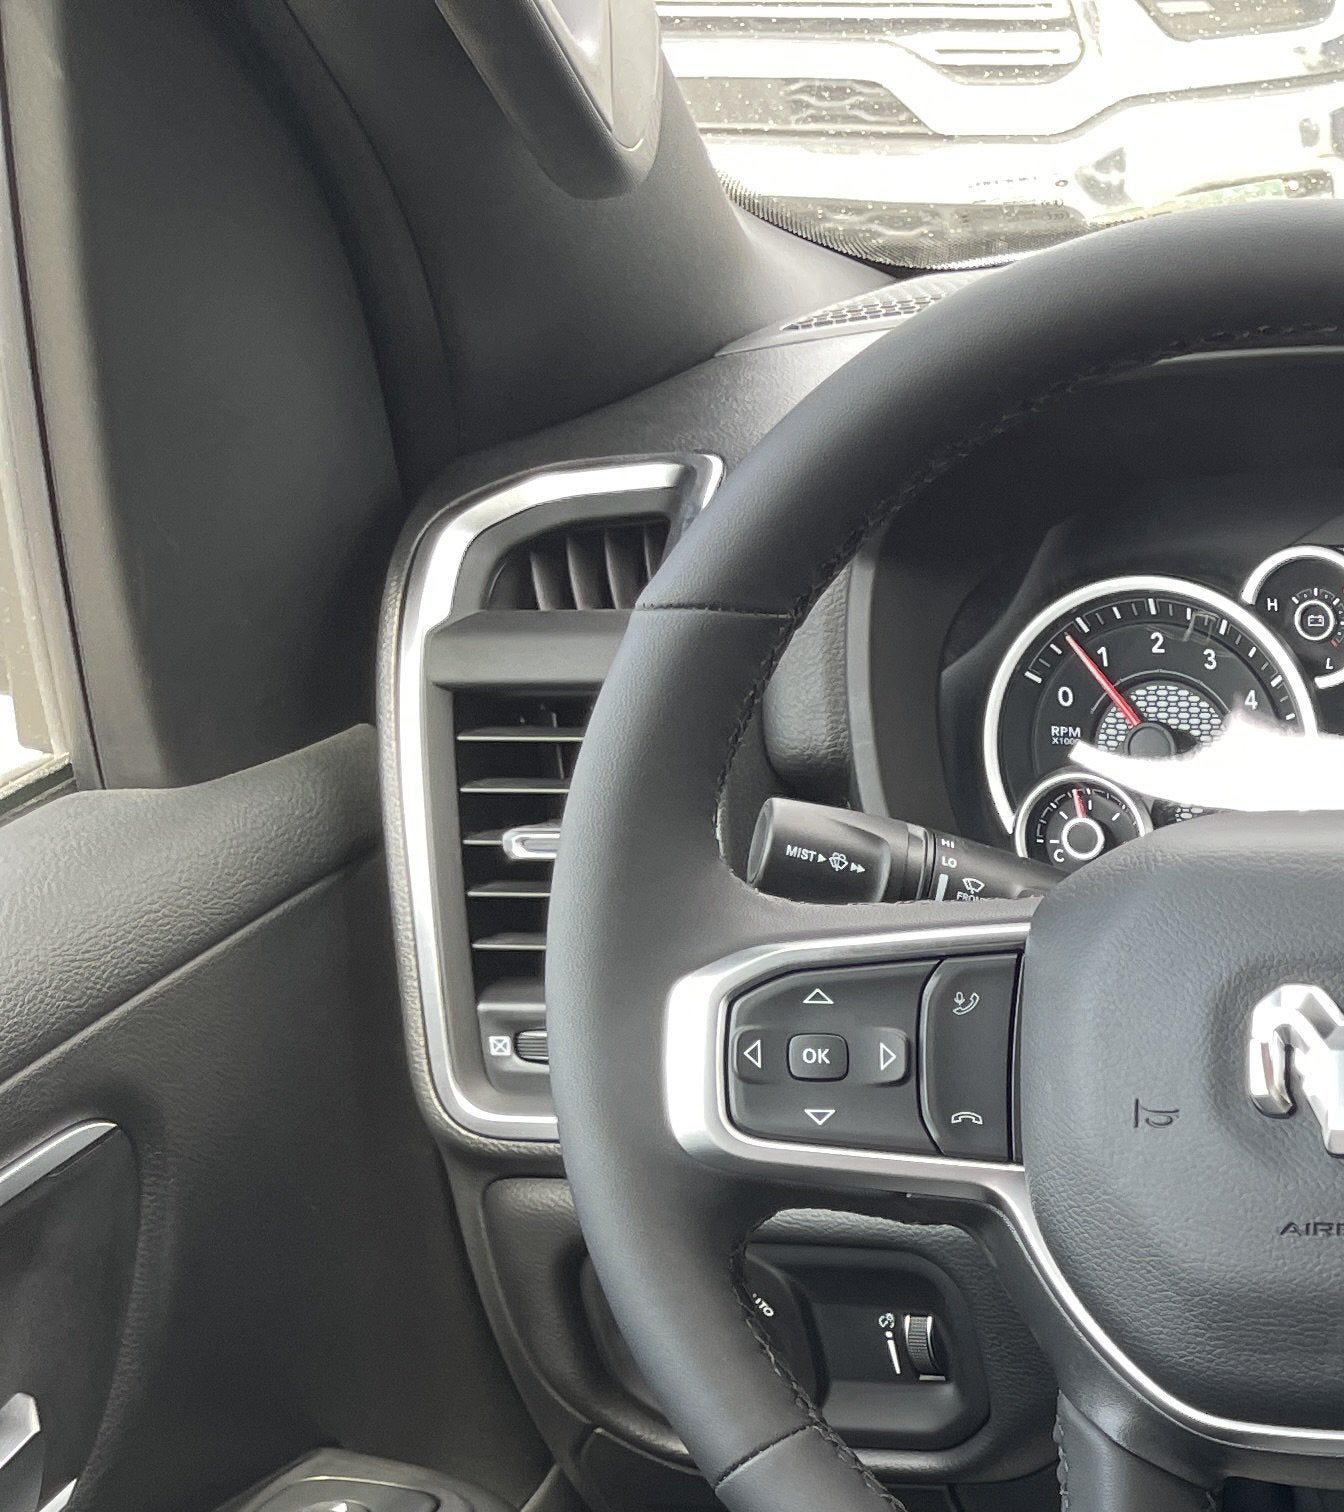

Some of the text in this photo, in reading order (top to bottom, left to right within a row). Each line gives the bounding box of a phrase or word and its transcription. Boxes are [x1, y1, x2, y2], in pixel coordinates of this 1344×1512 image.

[1267, 597, 1278, 611] H
[1150, 632, 1165, 653] 2
[1097, 646, 1108, 667] 1
[1203, 649, 1217, 670] 3
[1326, 658, 1333, 669] L
[1058, 687, 1073, 707] 0
[1245, 690, 1258, 710] 4
[1051, 726, 1081, 737] RPM
[942, 838, 955, 849] HI
[786, 845, 817, 862] MIST
[1053, 848, 1065, 862] C
[942, 856, 957, 868] LO
[803, 1048, 830, 1064] OK
